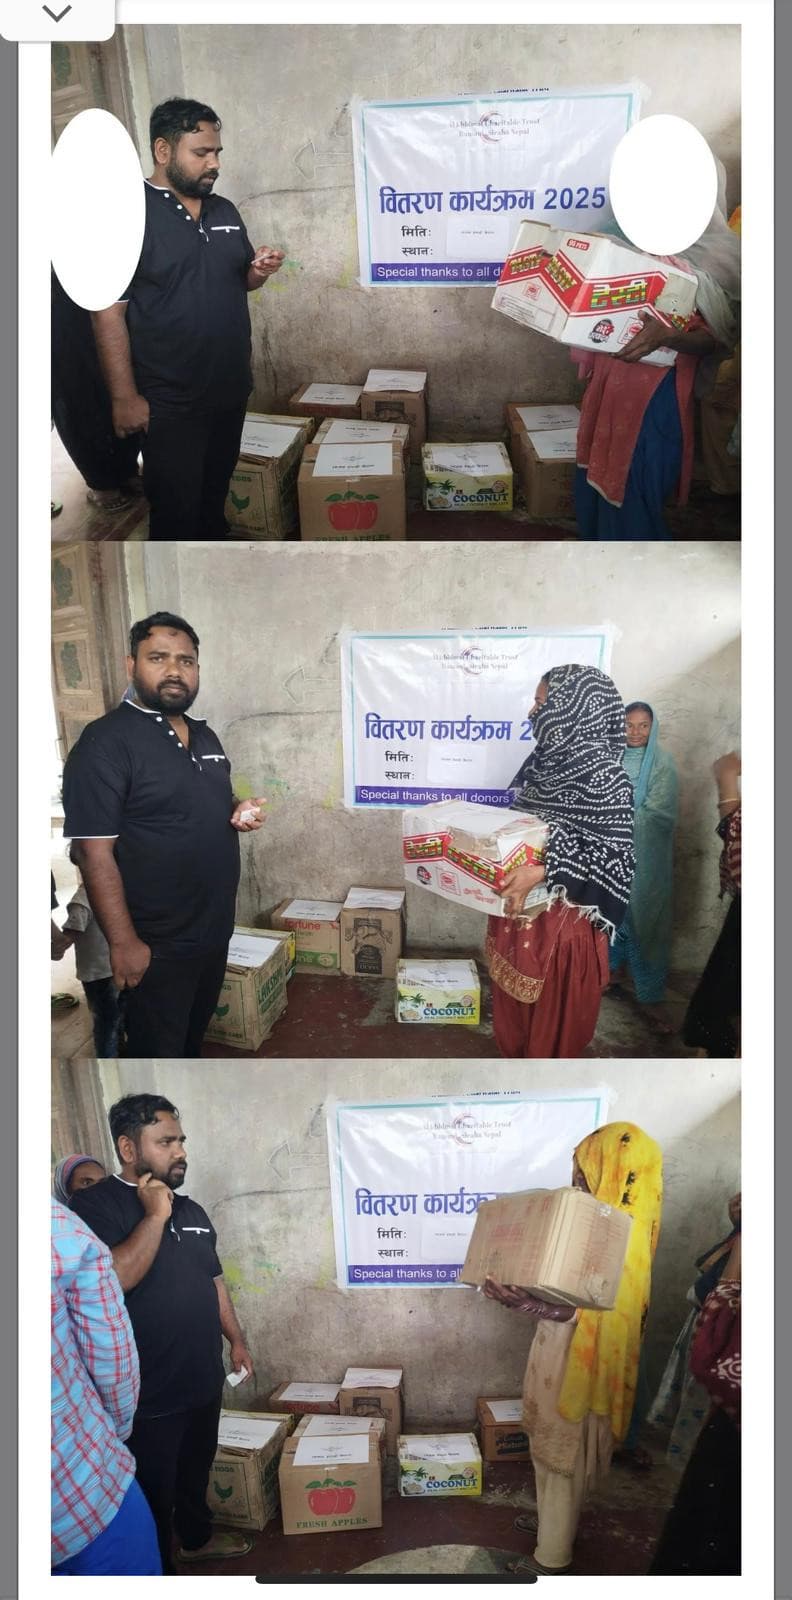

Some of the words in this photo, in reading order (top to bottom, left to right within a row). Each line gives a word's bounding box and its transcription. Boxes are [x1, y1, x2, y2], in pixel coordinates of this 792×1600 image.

[379, 185, 443, 214] वितरण
[450, 184, 535, 213] कार्यक्रम
[543, 186, 606, 210] 2025
[401, 225, 432, 238] मिति:
[377, 266, 418, 279] Special
[421, 266, 458, 277] thanks
[461, 267, 473, 277] to
[475, 265, 491, 276] all
[453, 494, 508, 502] COCONUT
[365, 712, 425, 740] वितरण
[431, 714, 512, 742] कार्यक्रम
[384, 750, 414, 763] मिति:
[360, 789, 400, 801] Special
[402, 790, 438, 802] thanks
[441, 791, 451, 801] to
[453, 792, 468, 802] all
[471, 792, 510, 804] donors
[423, 1007, 476, 1015] COCONUT
[355, 1187, 417, 1217] वितरण
[377, 1227, 407, 1239] मिति:
[353, 1268, 393, 1280] Special
[396, 1268, 433, 1279] thanks
[436, 1269, 447, 1279] to
[426, 1479, 477, 1488] COCONUT
[296, 1520, 327, 1529] FRESH
[331, 1517, 368, 1527] APPLES
